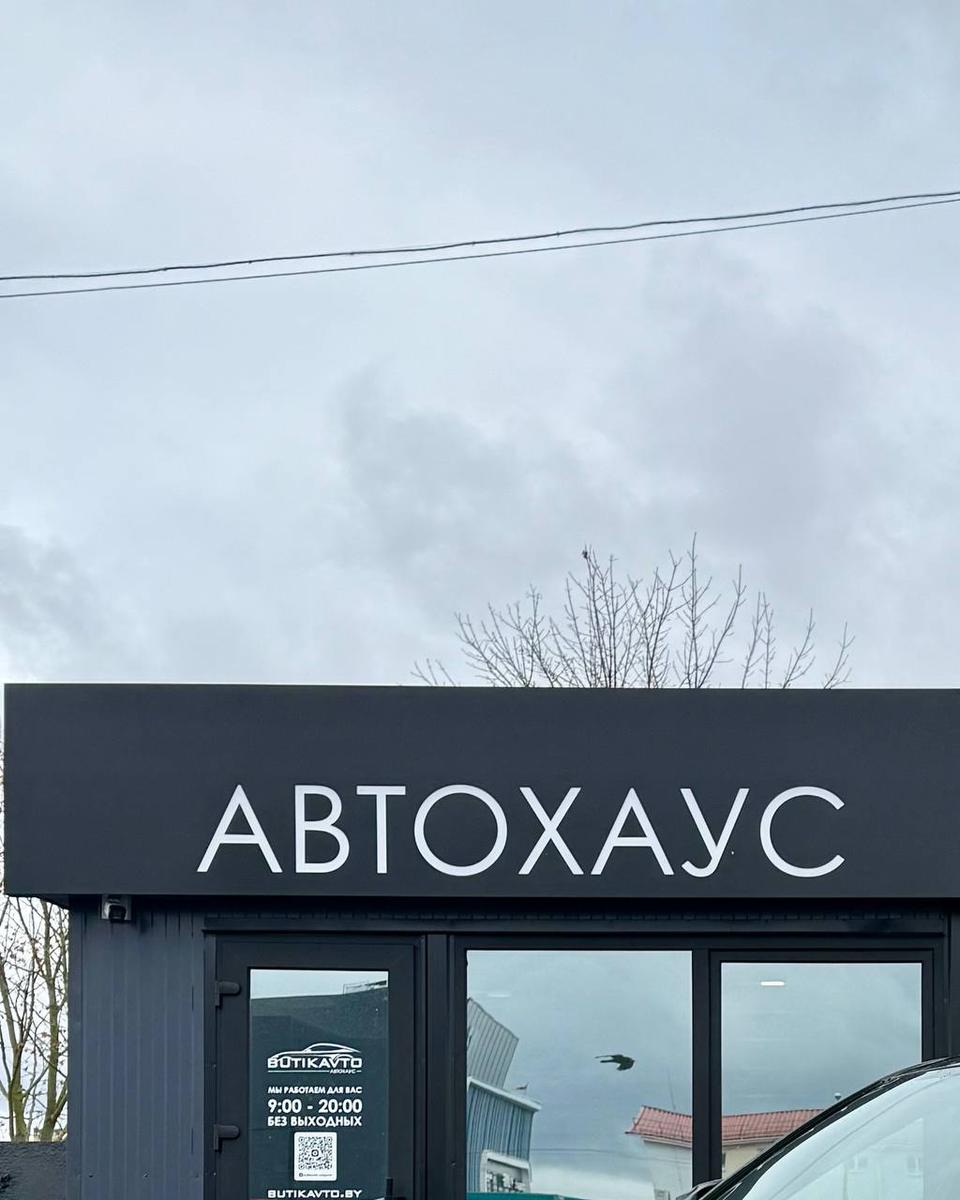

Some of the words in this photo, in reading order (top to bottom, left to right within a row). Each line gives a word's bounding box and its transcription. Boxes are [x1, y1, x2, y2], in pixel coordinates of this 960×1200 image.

[197, 783, 845, 879] АВТОХАУС
[267, 1057, 363, 1069] BUTIKAVTO
[267, 1086, 283, 1094] МЫ
[284, 1086, 326, 1094] РАБОТАЕМ
[327, 1086, 344, 1095] ДЛЯ
[345, 1086, 363, 1094] ВАС
[267, 1099, 302, 1113] 9:00
[318, 1099, 363, 1113] 20:00
[267, 1115, 288, 1127] БЕЗ
[290, 1115, 363, 1128] ВЫХОДНЫХ
[267, 1189, 363, 1199] BUTIKAVTO.BY
